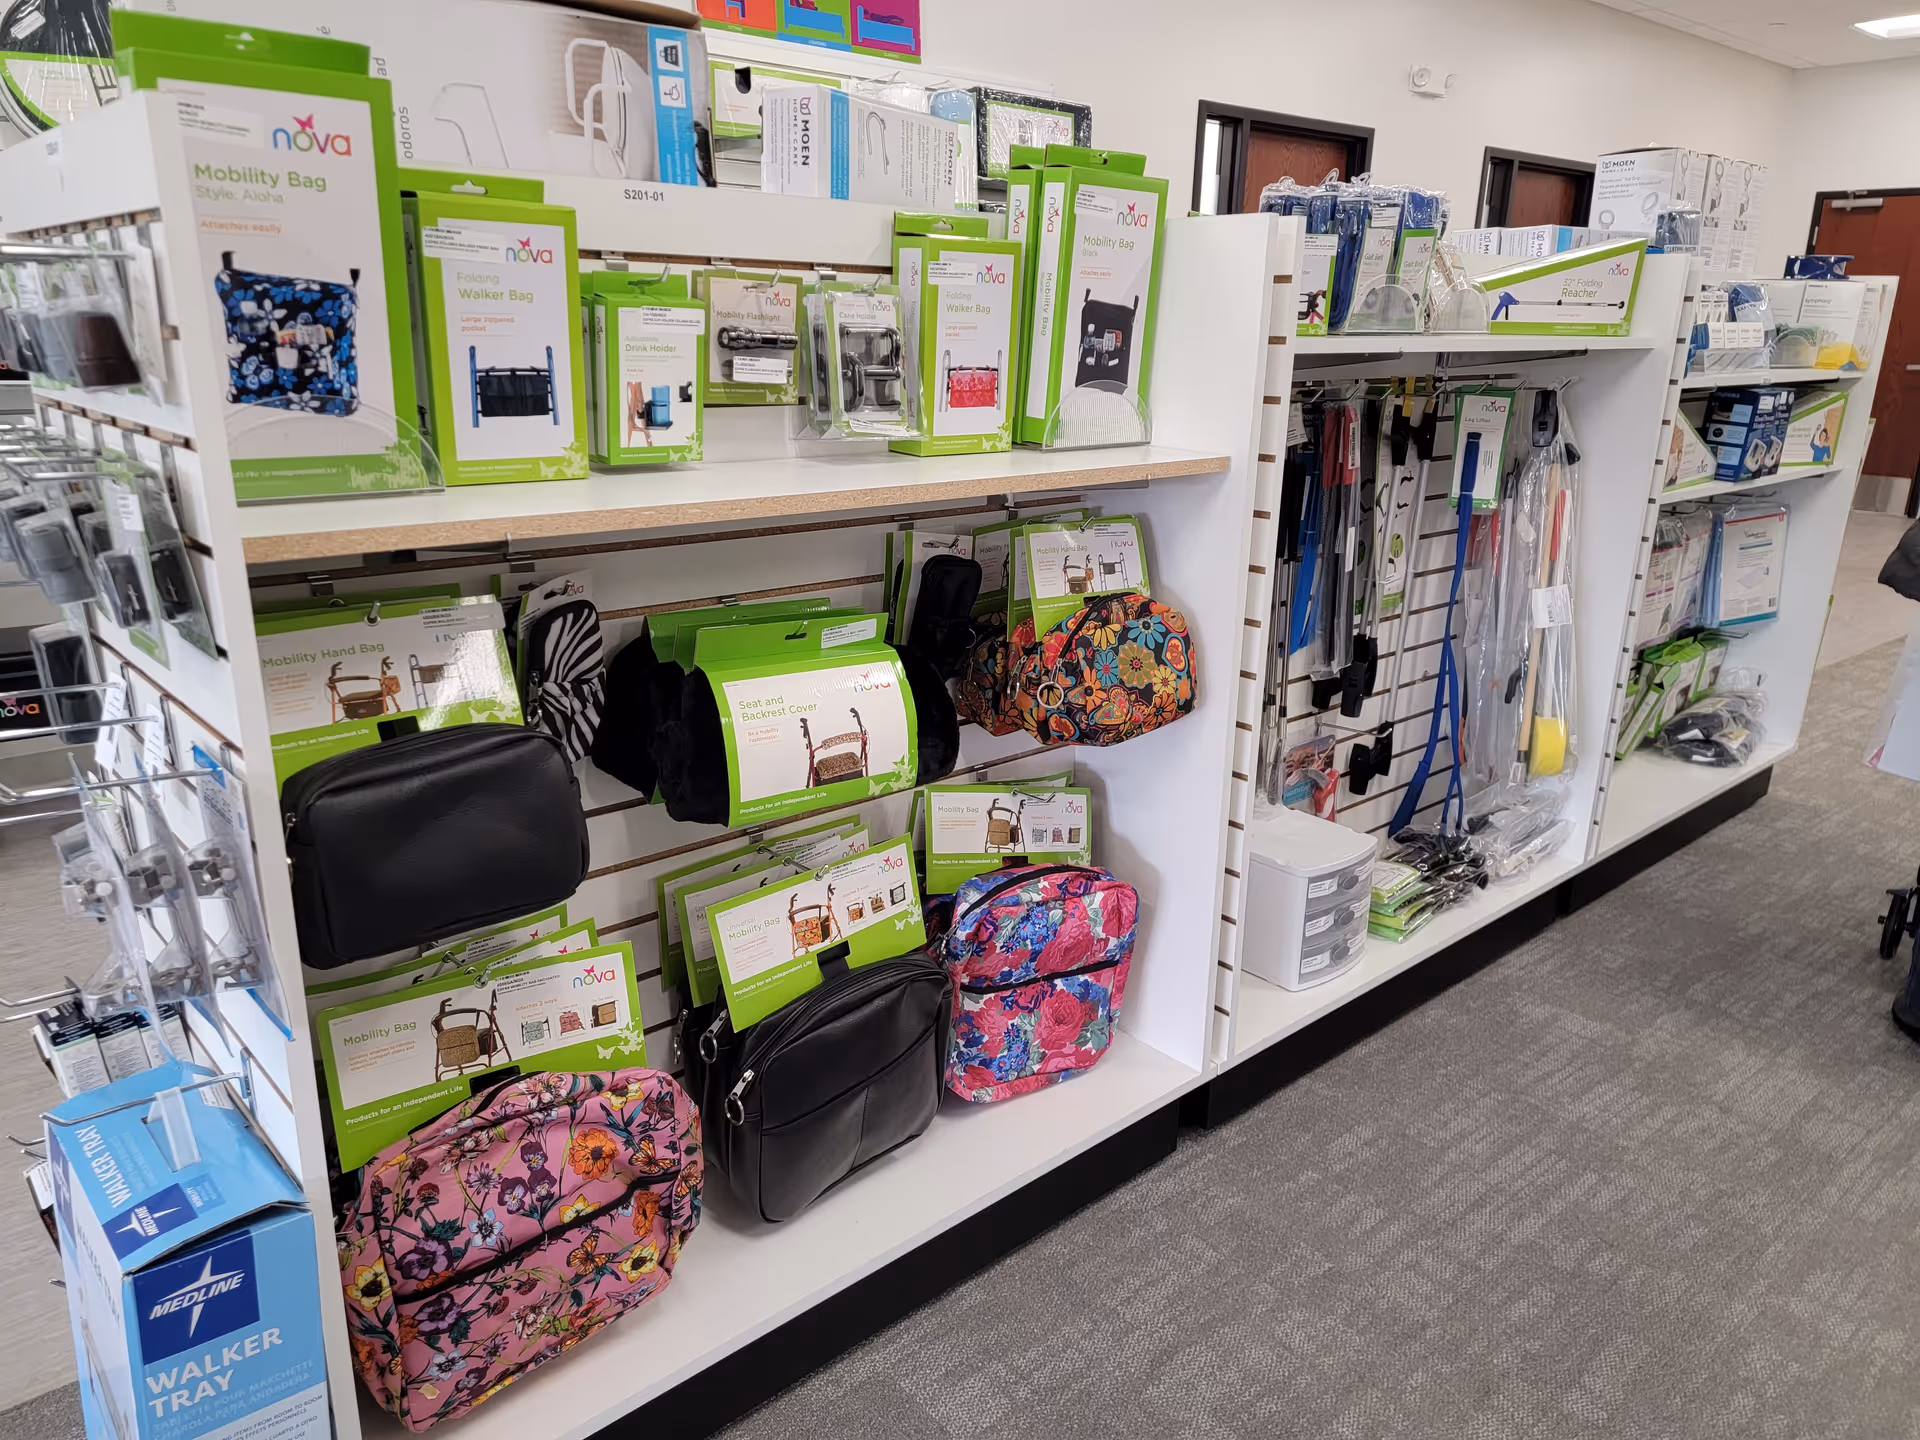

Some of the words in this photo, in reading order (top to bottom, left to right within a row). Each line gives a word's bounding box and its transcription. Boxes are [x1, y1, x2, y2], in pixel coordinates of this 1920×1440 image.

[272, 126, 352, 157] nova
[801, 119, 810, 166] MOEN
[1612, 160, 1636, 168] MOEN
[193, 163, 280, 189] Mobility
[287, 171, 327, 193] Bag
[243, 189, 284, 204] Aloha
[623, 188, 665, 202] S201-01
[1013, 198, 1023, 234] nova
[1046, 196, 1057, 233] nova
[1116, 210, 1149, 228] nova
[1083, 234, 1117, 250] Mobility
[1118, 237, 1135, 251] Bag
[505, 245, 553, 264] nova
[1082, 248, 1099, 257] Black
[456, 271, 500, 285] Folding
[976, 270, 1006, 284] nova
[1608, 265, 1629, 276] nova
[1042, 272, 1053, 313] Mobility
[1562, 278, 1576, 288] 32"
[1576, 278, 1603, 289] Folding
[1562, 287, 1598, 298] Reacher
[457, 287, 505, 301] Walker
[508, 289, 534, 304] Bag
[765, 295, 791, 307] nova
[946, 291, 972, 301] Folding
[716, 310, 745, 321] Mobility
[746, 310, 781, 322] Flashlight
[946, 304, 973, 314] Walker
[975, 304, 991, 315] Bag
[1040, 316, 1050, 337] Bag
[625, 343, 648, 352] Drink
[650, 344, 677, 353] Holder
[1482, 404, 1506, 412] nova
[980, 544, 1002, 554] Mobility
[1036, 546, 1060, 555] Mobility
[262, 650, 317, 668] Mobility
[320, 645, 357, 660] Hand
[360, 641, 385, 654] Bag
[738, 698, 763, 710] Seat
[764, 695, 784, 706] and
[741, 707, 787, 722] Backrest
[788, 702, 818, 715] Cover
[740, 805, 765, 815] Products
[782, 794, 816, 804] Independent
[938, 806, 965, 815] Mobility
[966, 806, 980, 815] Bag
[728, 923, 762, 941] Mobility
[764, 916, 781, 928] Bag
[572, 969, 616, 989] nova
[733, 984, 757, 996] Products
[772, 964, 803, 980] Independent
[343, 1027, 391, 1047] Mobility
[394, 1020, 418, 1034] Bag
[346, 1111, 379, 1126] Products
[380, 1107, 392, 1116] for
[402, 1088, 449, 1108] Independent
[450, 1084, 464, 1094] Life
[74, 1124, 106, 1159] TRAY
[90, 1151, 133, 1209] WALKER
[134, 1205, 160, 1237] MEDLINE
[148, 1271, 245, 1321] MEDLINE
[145, 1326, 283, 1395] WALKER
[148, 1368, 235, 1418] TRAY
[254, 1417, 272, 1429] FROM
[274, 1408, 293, 1420] ROOM
[294, 1403, 303, 1411] TO
[304, 1394, 323, 1406] ROOM
[268, 1408, 308, 1429] PERSONNELS
[300, 1416, 318, 1427] OTRO
